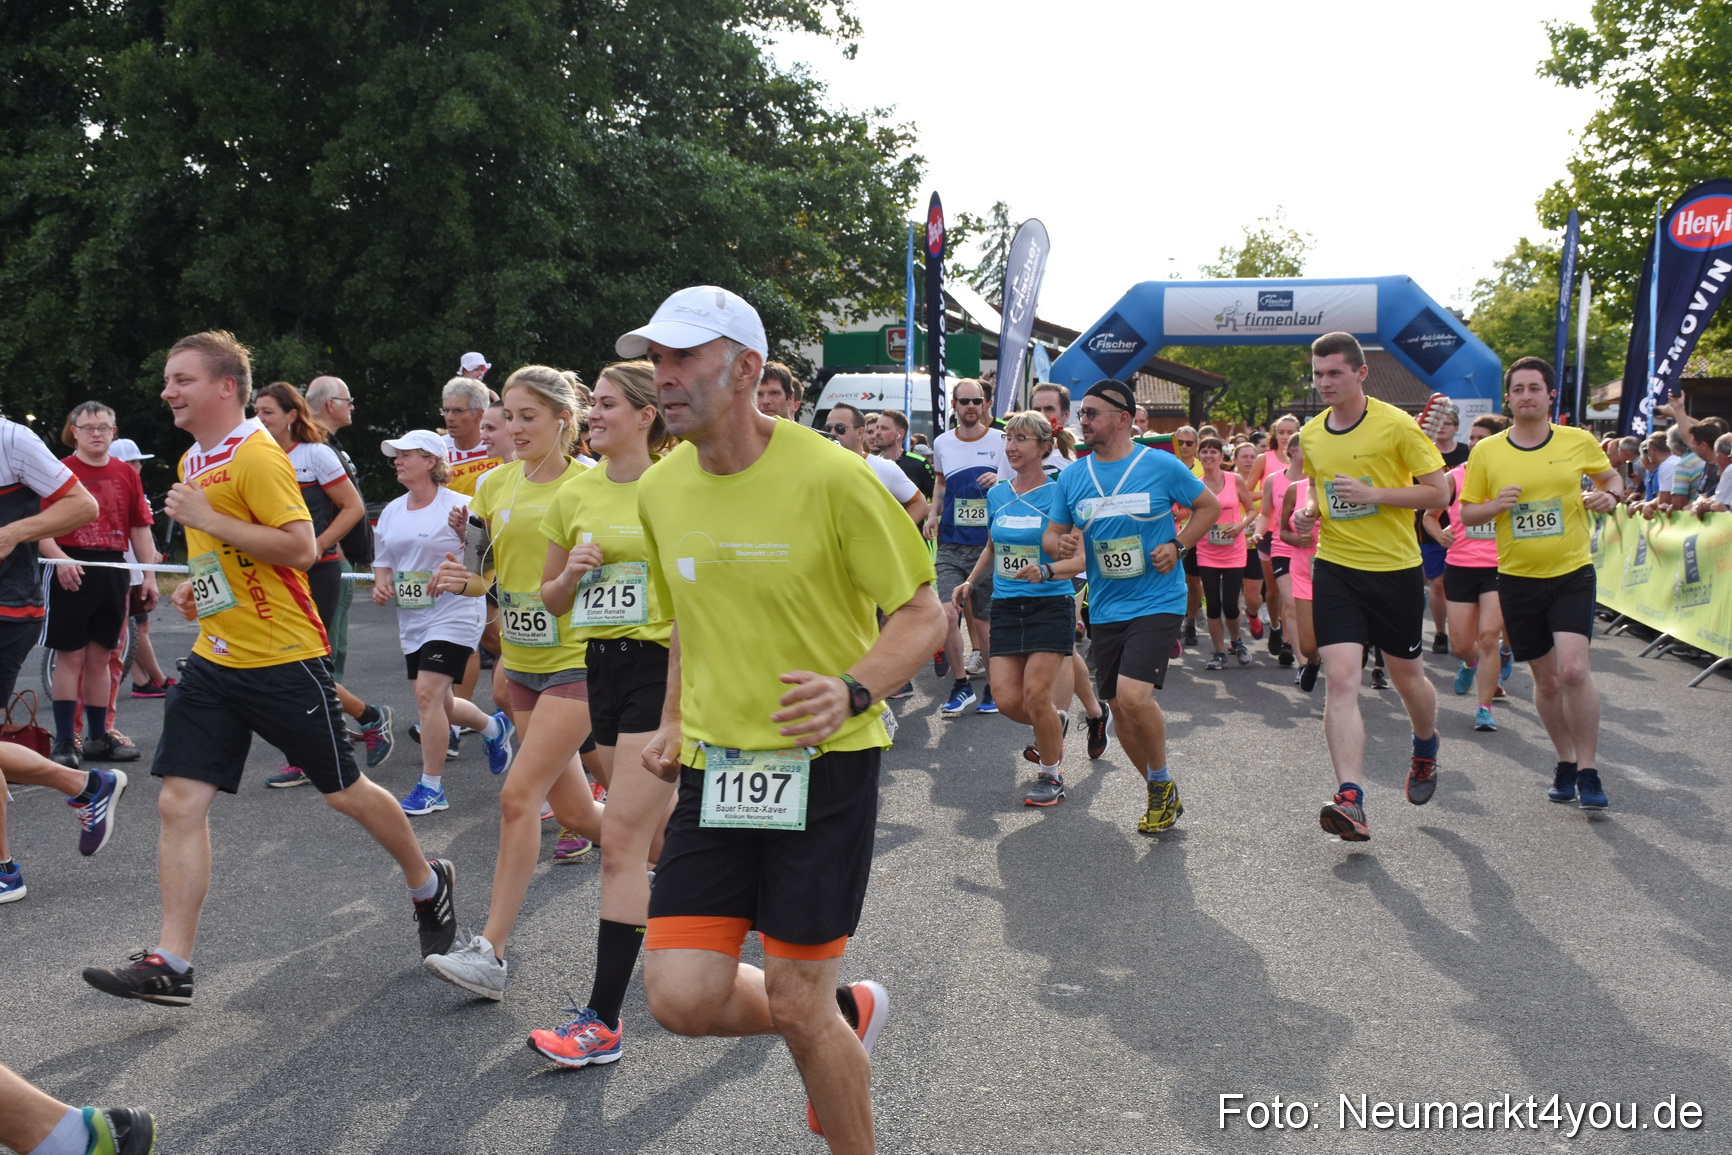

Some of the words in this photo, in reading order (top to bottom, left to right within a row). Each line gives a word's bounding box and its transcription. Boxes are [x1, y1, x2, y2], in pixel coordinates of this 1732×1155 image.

[1677, 208, 1732, 238] Hervi
[1263, 295, 1292, 305] Fischer
[1244, 311, 1324, 327] firmenlauf
[1094, 335, 1138, 350] Fischer
[958, 508, 985, 519] 2128
[1516, 512, 1557, 530] 2186
[1003, 556, 1029, 571] 840
[1103, 552, 1132, 568] 839
[399, 584, 423, 598] 648
[582, 585, 637, 609] 1215
[504, 609, 547, 632] 1256
[779, 764, 802, 773] 2019
[716, 771, 792, 804] 1197
[716, 804, 736, 812] Bauer
[737, 804, 788, 814] Franz-Xaver
